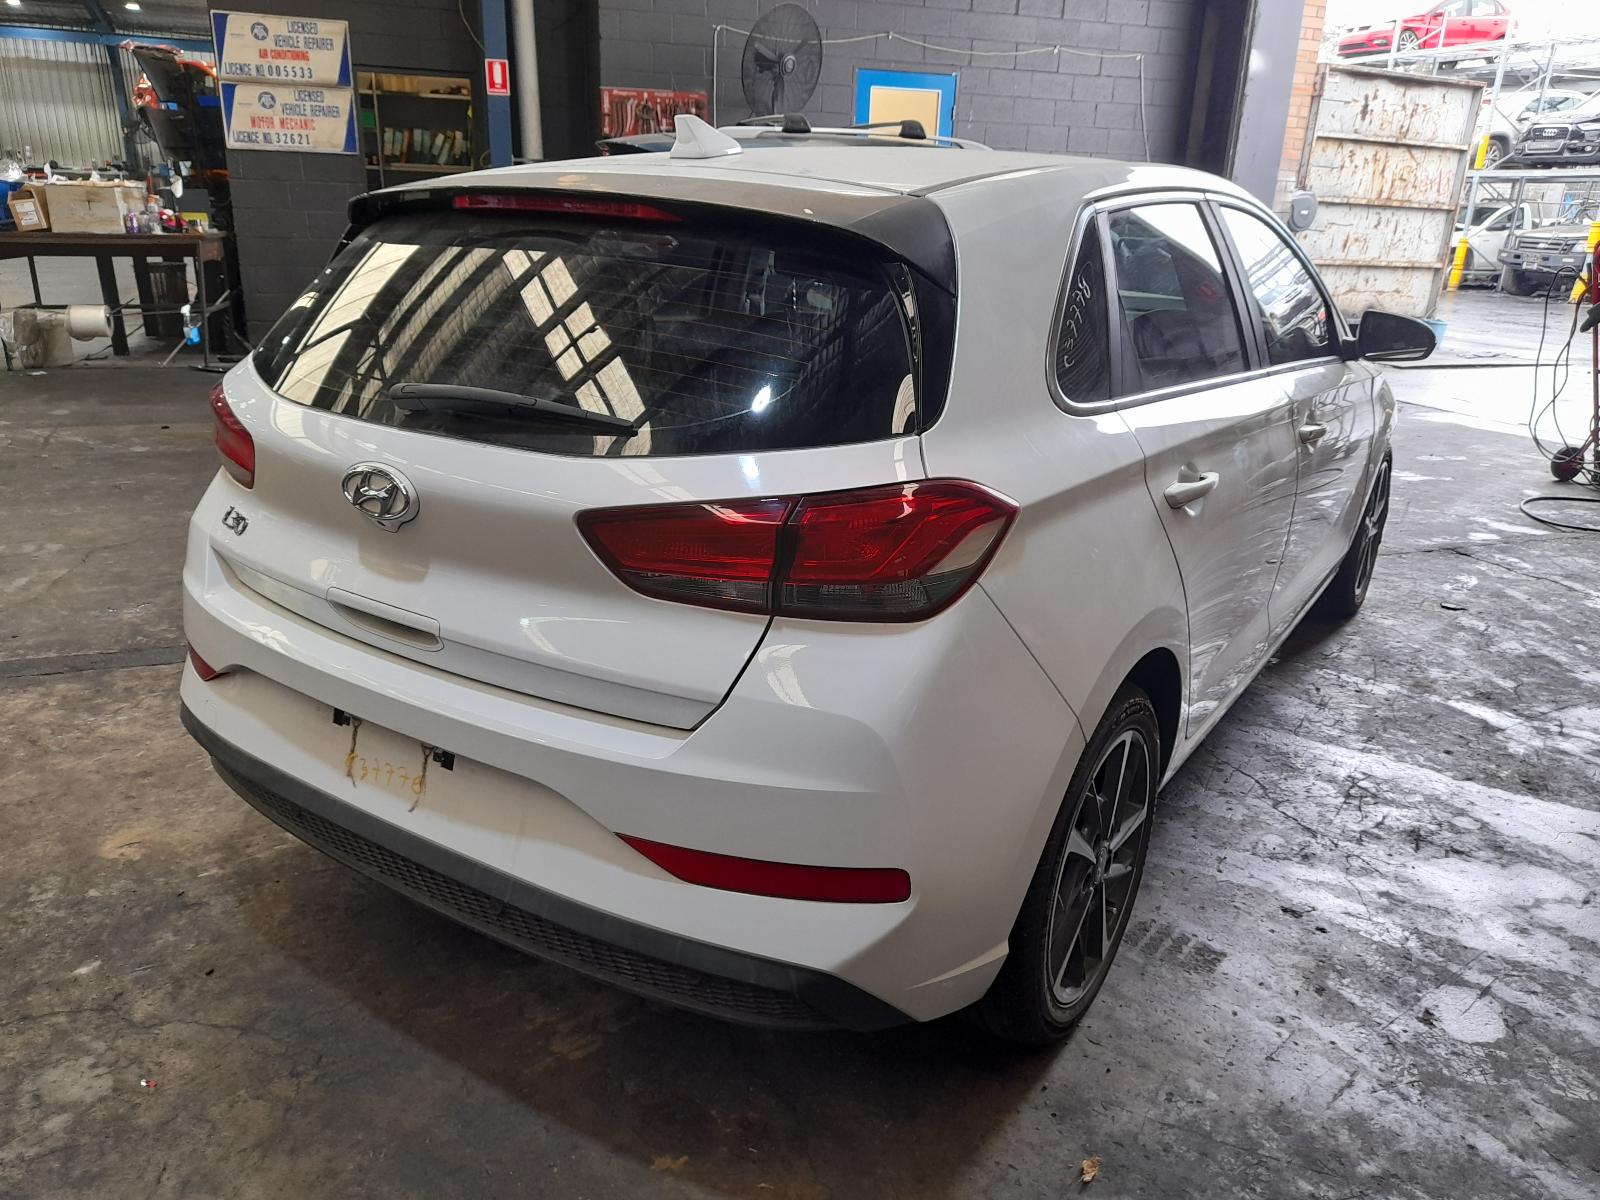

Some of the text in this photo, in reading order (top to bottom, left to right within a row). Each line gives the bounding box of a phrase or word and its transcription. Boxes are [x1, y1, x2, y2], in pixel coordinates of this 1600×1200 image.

[287, 20, 318, 34] LICENSED
[273, 35, 334, 51] VEHICLE REPAIRER
[259, 48, 310, 61] AIR CONDITIONING
[224, 62, 252, 76] LICENCE
[267, 65, 313, 79] 005533
[293, 90, 325, 103] LICENSED
[280, 103, 340, 118] VEHICLE REPAIRER
[250, 115, 316, 131] MOTOR MECHANIC
[232, 130, 259, 144] LICENCE
[275, 133, 311, 145] 32621
